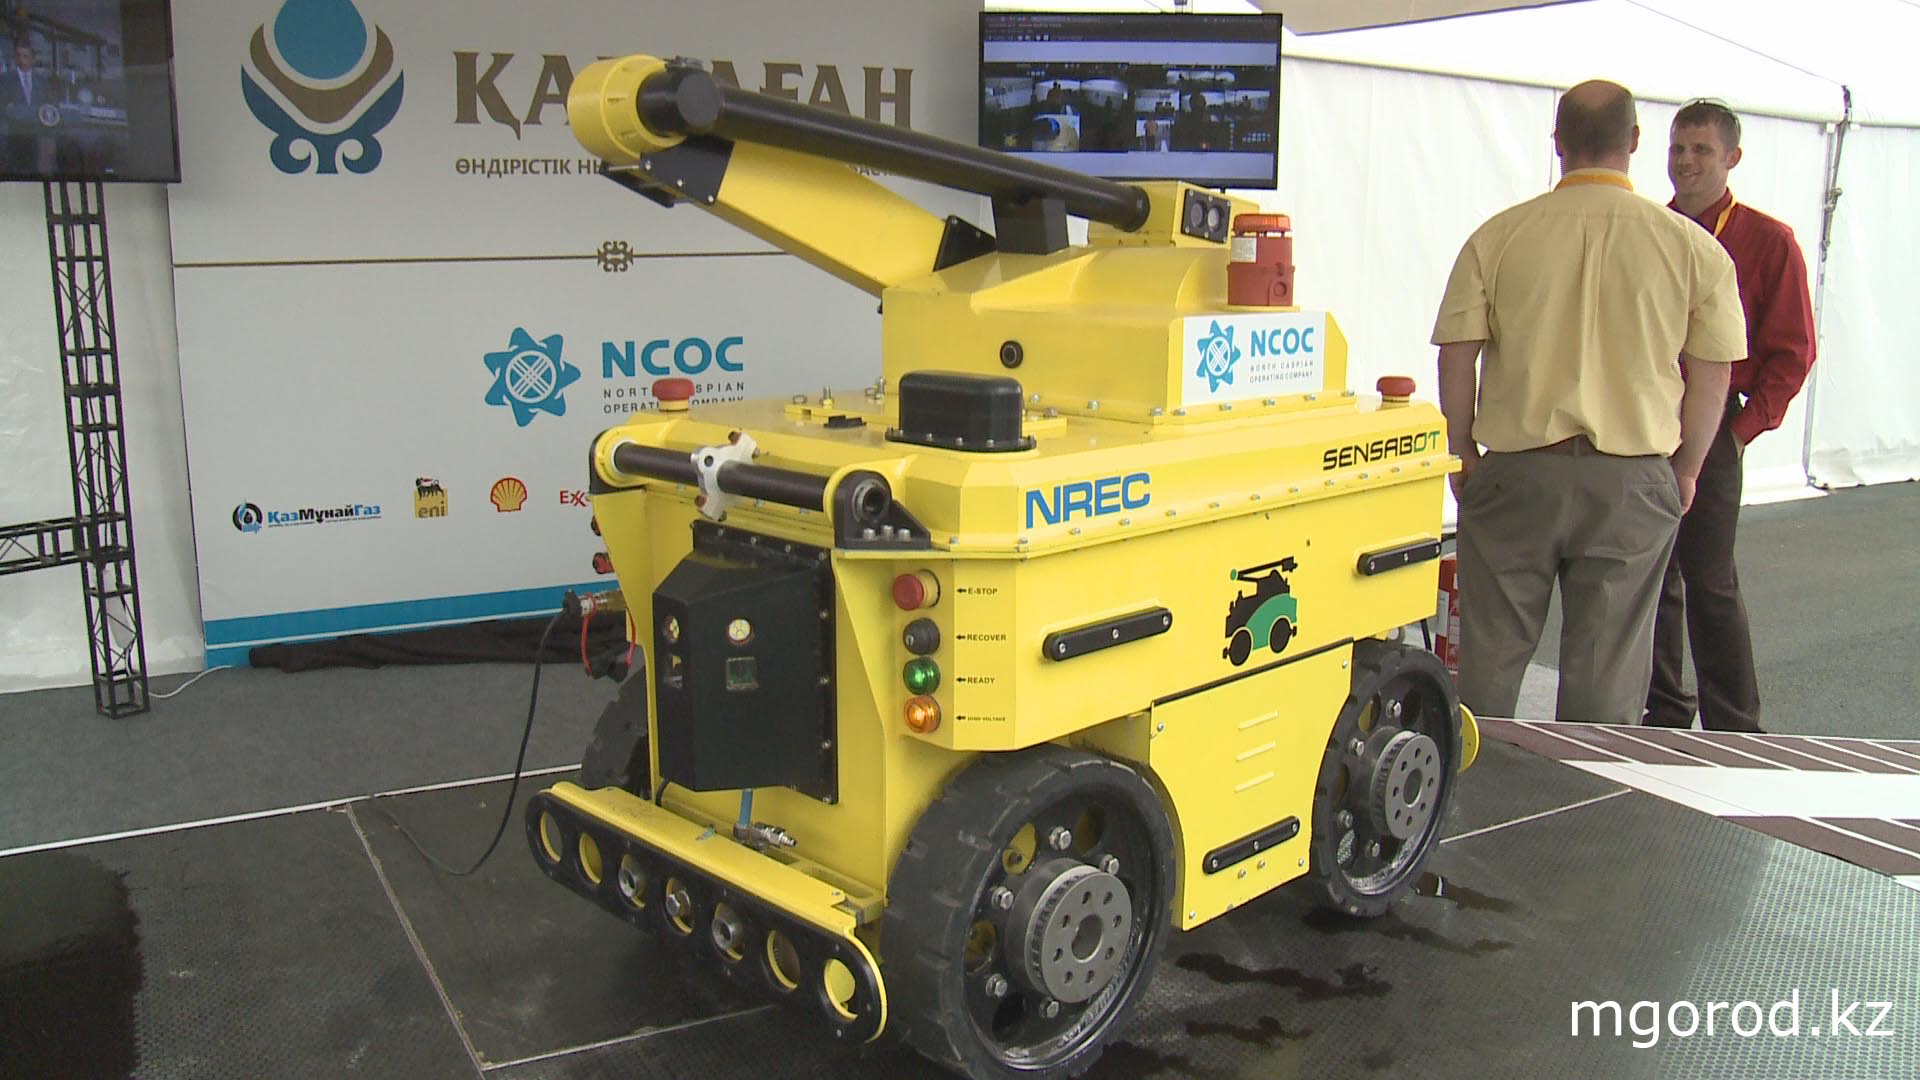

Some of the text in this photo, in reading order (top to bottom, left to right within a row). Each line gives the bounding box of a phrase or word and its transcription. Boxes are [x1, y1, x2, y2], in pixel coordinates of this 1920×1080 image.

[455, 158, 572, 179] ӨНДІРІСТІК
[1250, 327, 1314, 357] NCOC
[602, 336, 743, 378] NCOC
[1250, 359, 1314, 372] NORTH CASPIAN
[603, 382, 744, 399] NORT SPIAN
[1323, 430, 1441, 471] SENSABOT
[419, 500, 445, 518] eni
[1025, 472, 1151, 529] NREC
[968, 587, 998, 596] E-STOP
[967, 633, 1007, 642] RECOVER
[968, 676, 996, 685] READY
